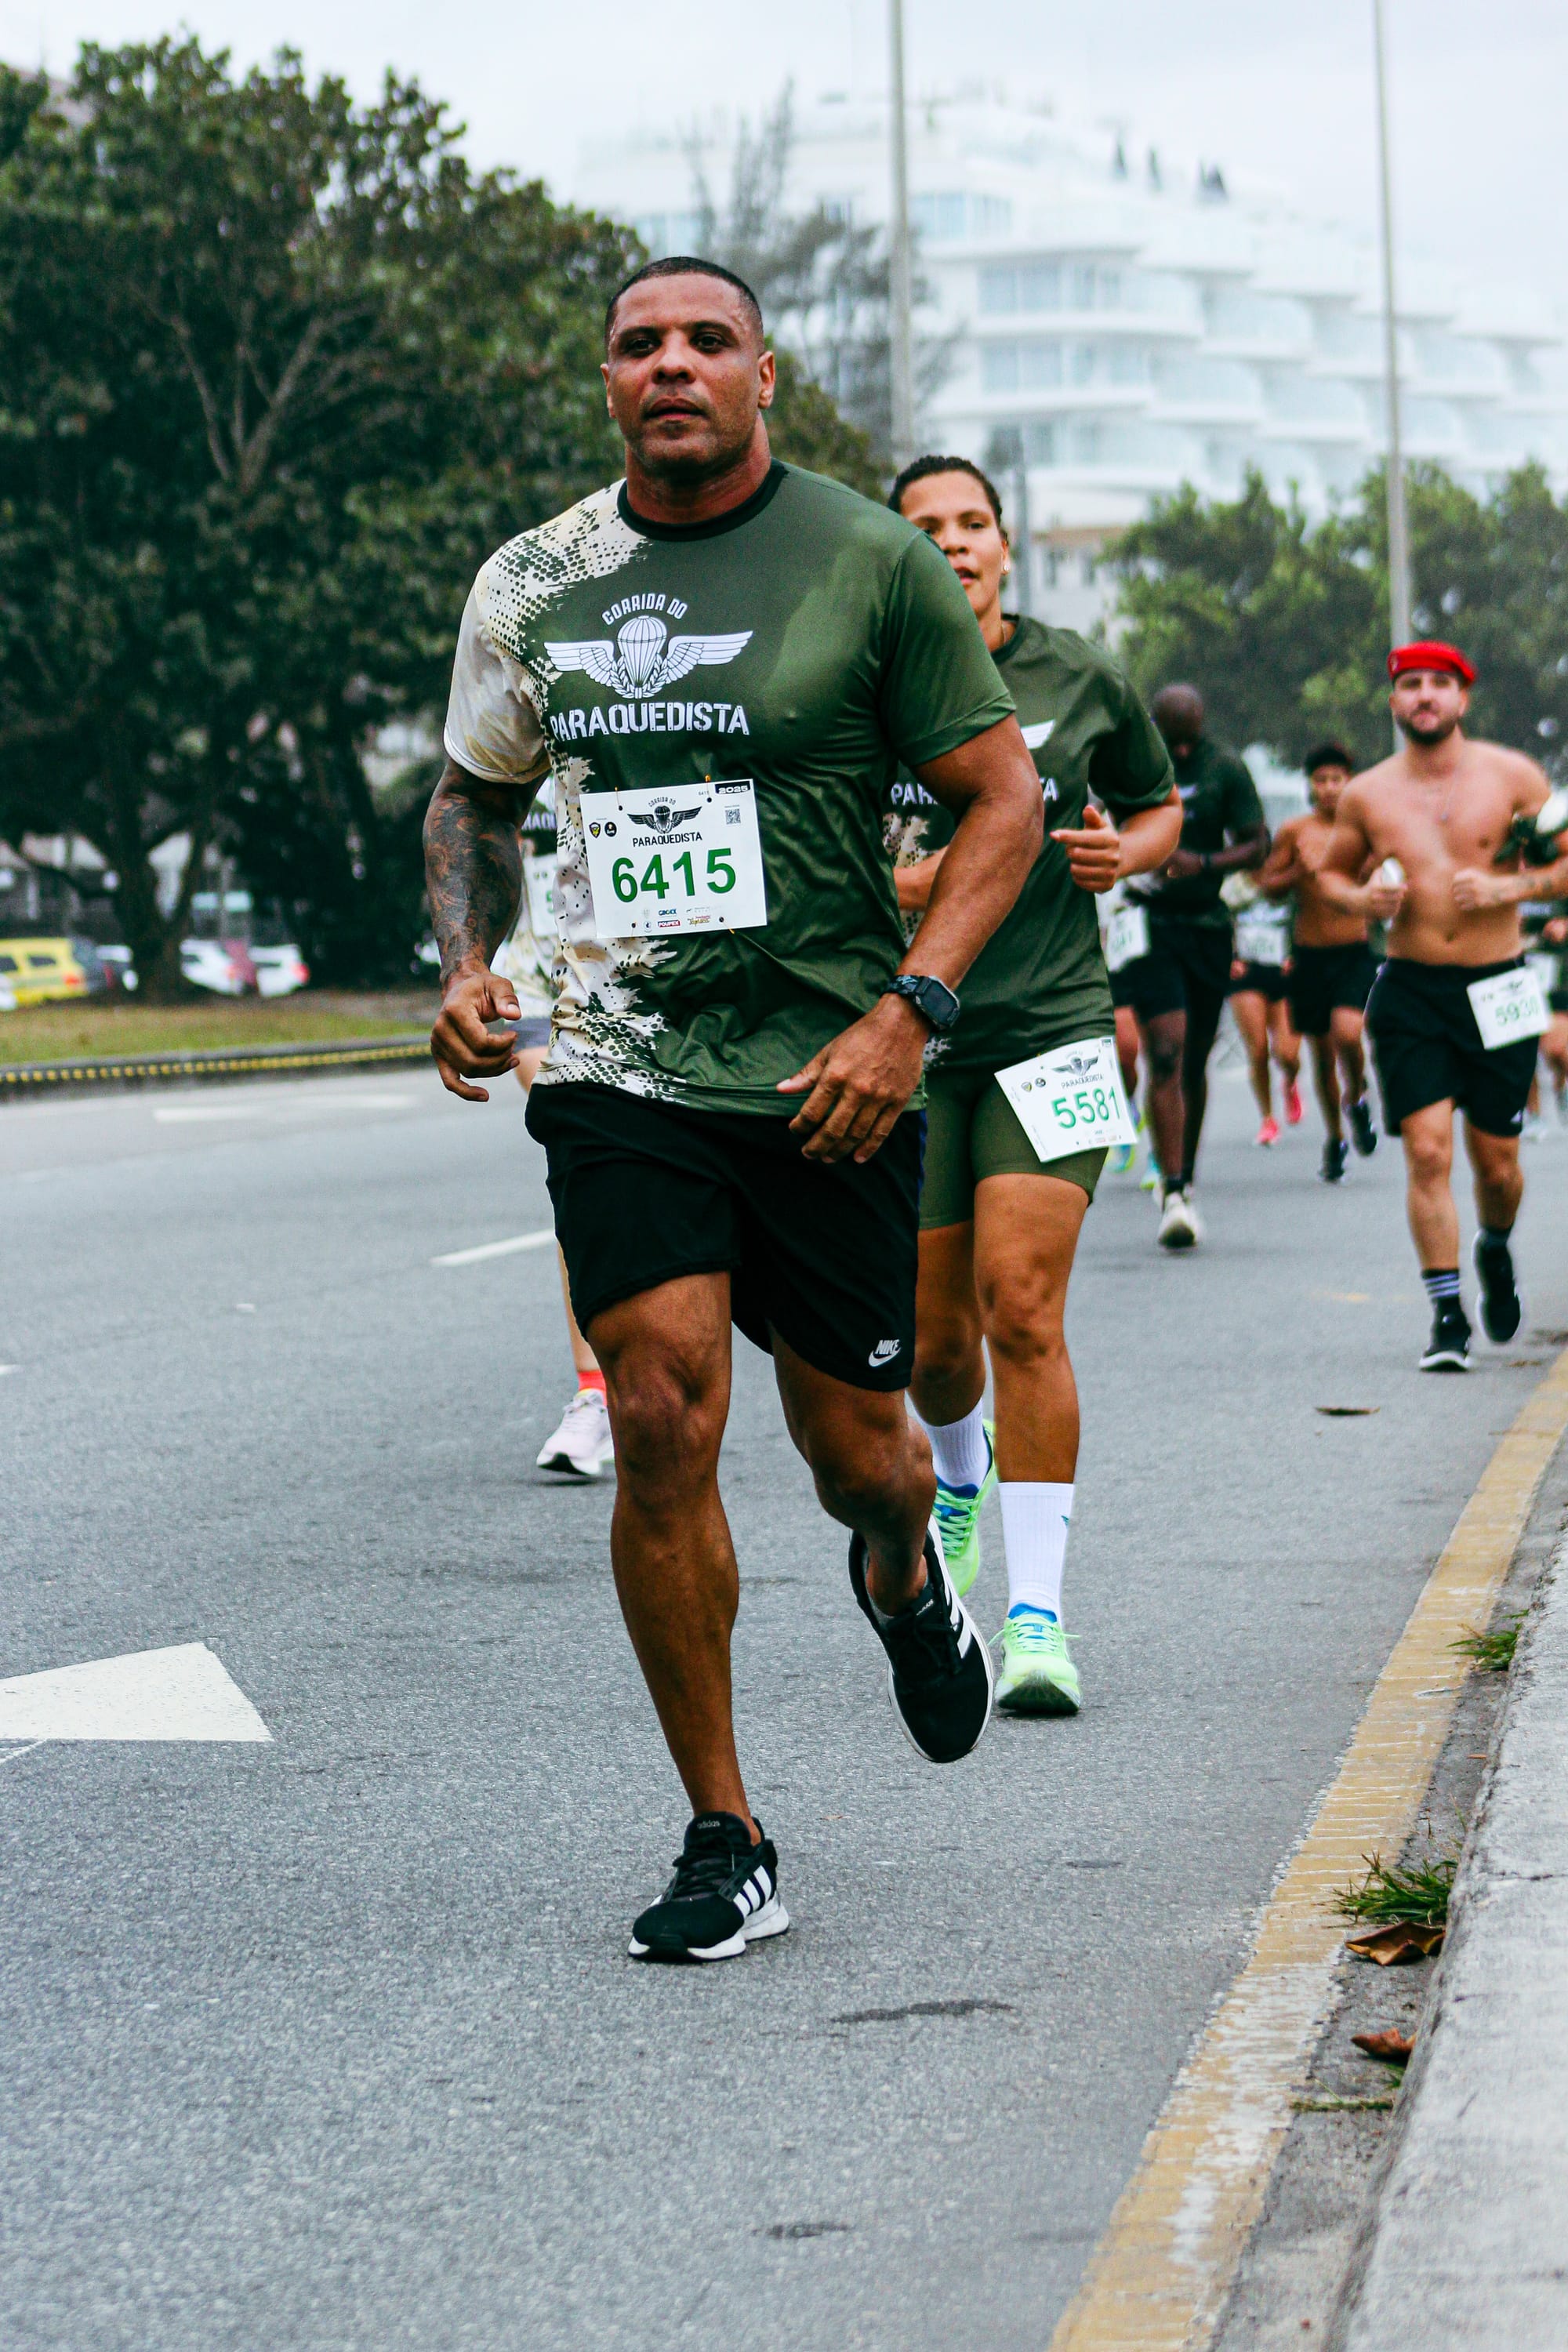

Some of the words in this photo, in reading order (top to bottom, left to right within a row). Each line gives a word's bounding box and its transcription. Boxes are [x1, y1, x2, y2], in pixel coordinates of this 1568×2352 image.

[601, 593, 666, 626] CORRIDA
[666, 597, 688, 619] DO
[550, 702, 750, 742] PARAQUEDISTA
[718, 785, 749, 794] 2025
[633, 831, 703, 848] PARAQUEDISTA
[612, 848, 736, 903] 6415
[1061, 1073, 1104, 1089] PARAQUEDISTA
[1051, 1086, 1120, 1129] 5581
[874, 1338, 901, 1355] NIKE
